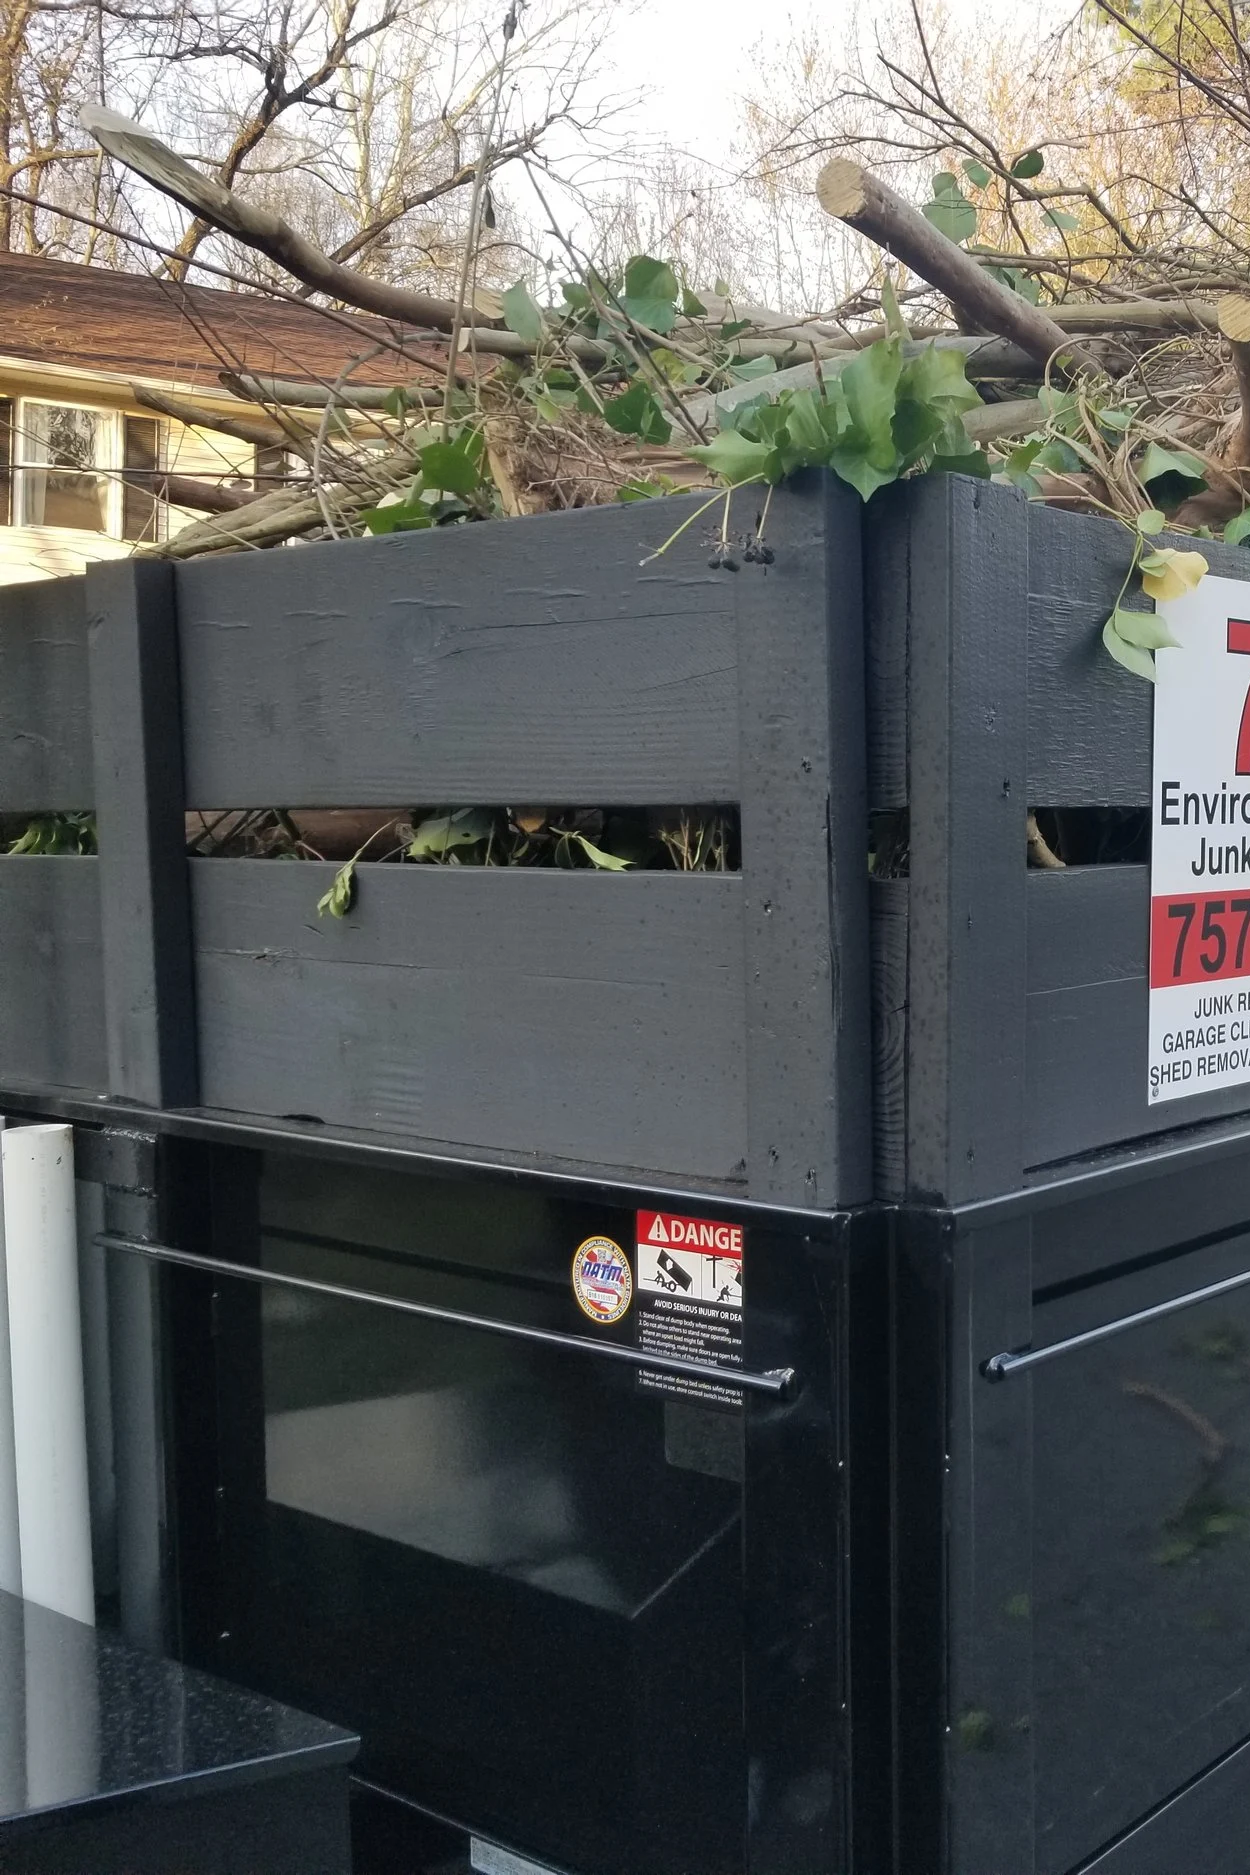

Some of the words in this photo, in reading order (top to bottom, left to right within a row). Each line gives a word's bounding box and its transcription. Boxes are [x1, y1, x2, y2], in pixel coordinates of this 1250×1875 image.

[1193, 994, 1234, 1019] JUNK
[1162, 1025, 1227, 1054] GARAGE
[1149, 1058, 1193, 1088] SHED
[654, 1299, 673, 1310] AVOID
[672, 1302, 698, 1314] SERIOUS
[698, 1307, 720, 1318] INJURY
[720, 1311, 729, 1320] OR
[670, 1317, 684, 1326] dump
[683, 1319, 695, 1328] body
[695, 1322, 708, 1330] when
[668, 1325, 683, 1334] others
[687, 1329, 700, 1337] stand
[710, 1333, 732, 1344] operating
[673, 1334, 684, 1342] load
[698, 1347, 711, 1356] doors
[718, 1352, 731, 1360] open
[642, 1370, 656, 1378] Never
[662, 1374, 676, 1383] under
[675, 1377, 689, 1386] dump
[688, 1379, 698, 1387] bed
[711, 1384, 726, 1394] safety
[725, 1388, 737, 1396] prop
